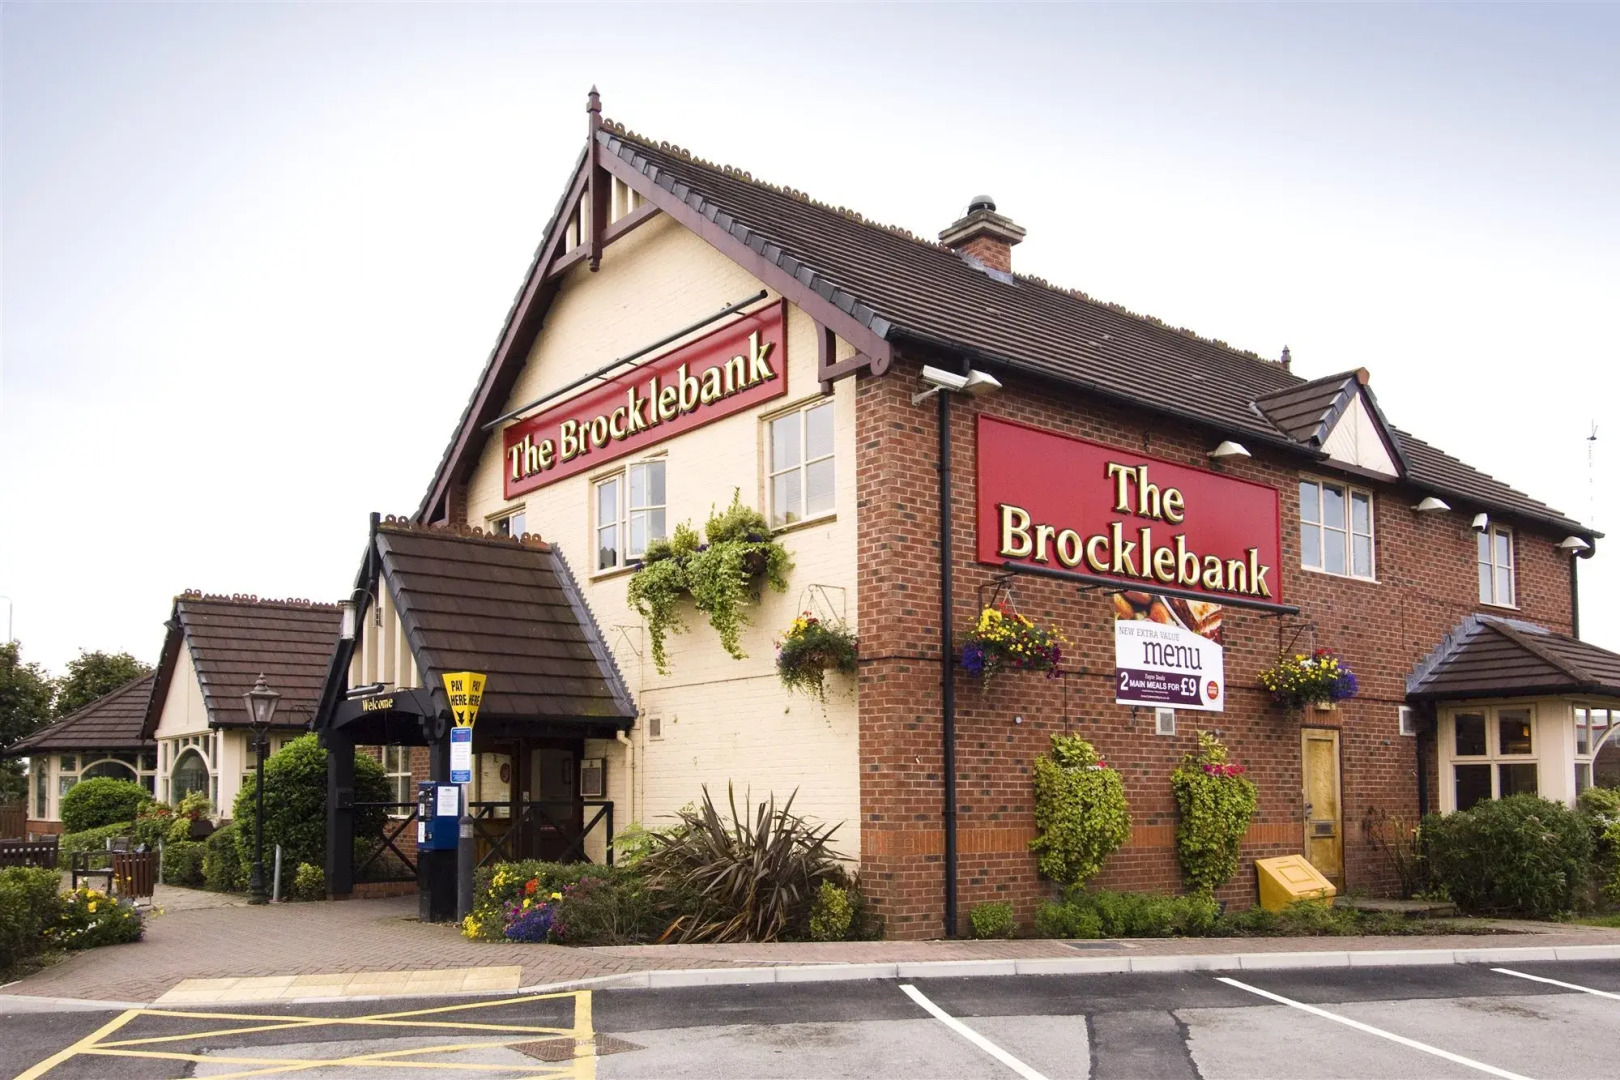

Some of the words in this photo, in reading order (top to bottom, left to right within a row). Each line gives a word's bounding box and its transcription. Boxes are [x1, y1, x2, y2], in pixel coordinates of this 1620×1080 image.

[507, 433, 555, 482] The
[559, 330, 776, 463] Brocklebank
[1107, 461, 1185, 524] The
[999, 503, 1272, 598] Brocklebank
[1119, 626, 1134, 636] NEW
[1137, 628, 1158, 639] EXTRA
[1160, 631, 1180, 641] VALUE
[1143, 641, 1202, 670] menu
[451, 680, 462, 691] PAY
[472, 680, 481, 692] PAY
[1120, 672, 1129, 690] 2
[1129, 679, 1145, 688] MAIN
[1147, 681, 1167, 690] MEALS
[1168, 683, 1180, 691] FOR
[1180, 678, 1197, 696] £9
[362, 697, 393, 712] Welcome
[451, 695, 467, 706] HERE
[469, 695, 480, 706] HERE
